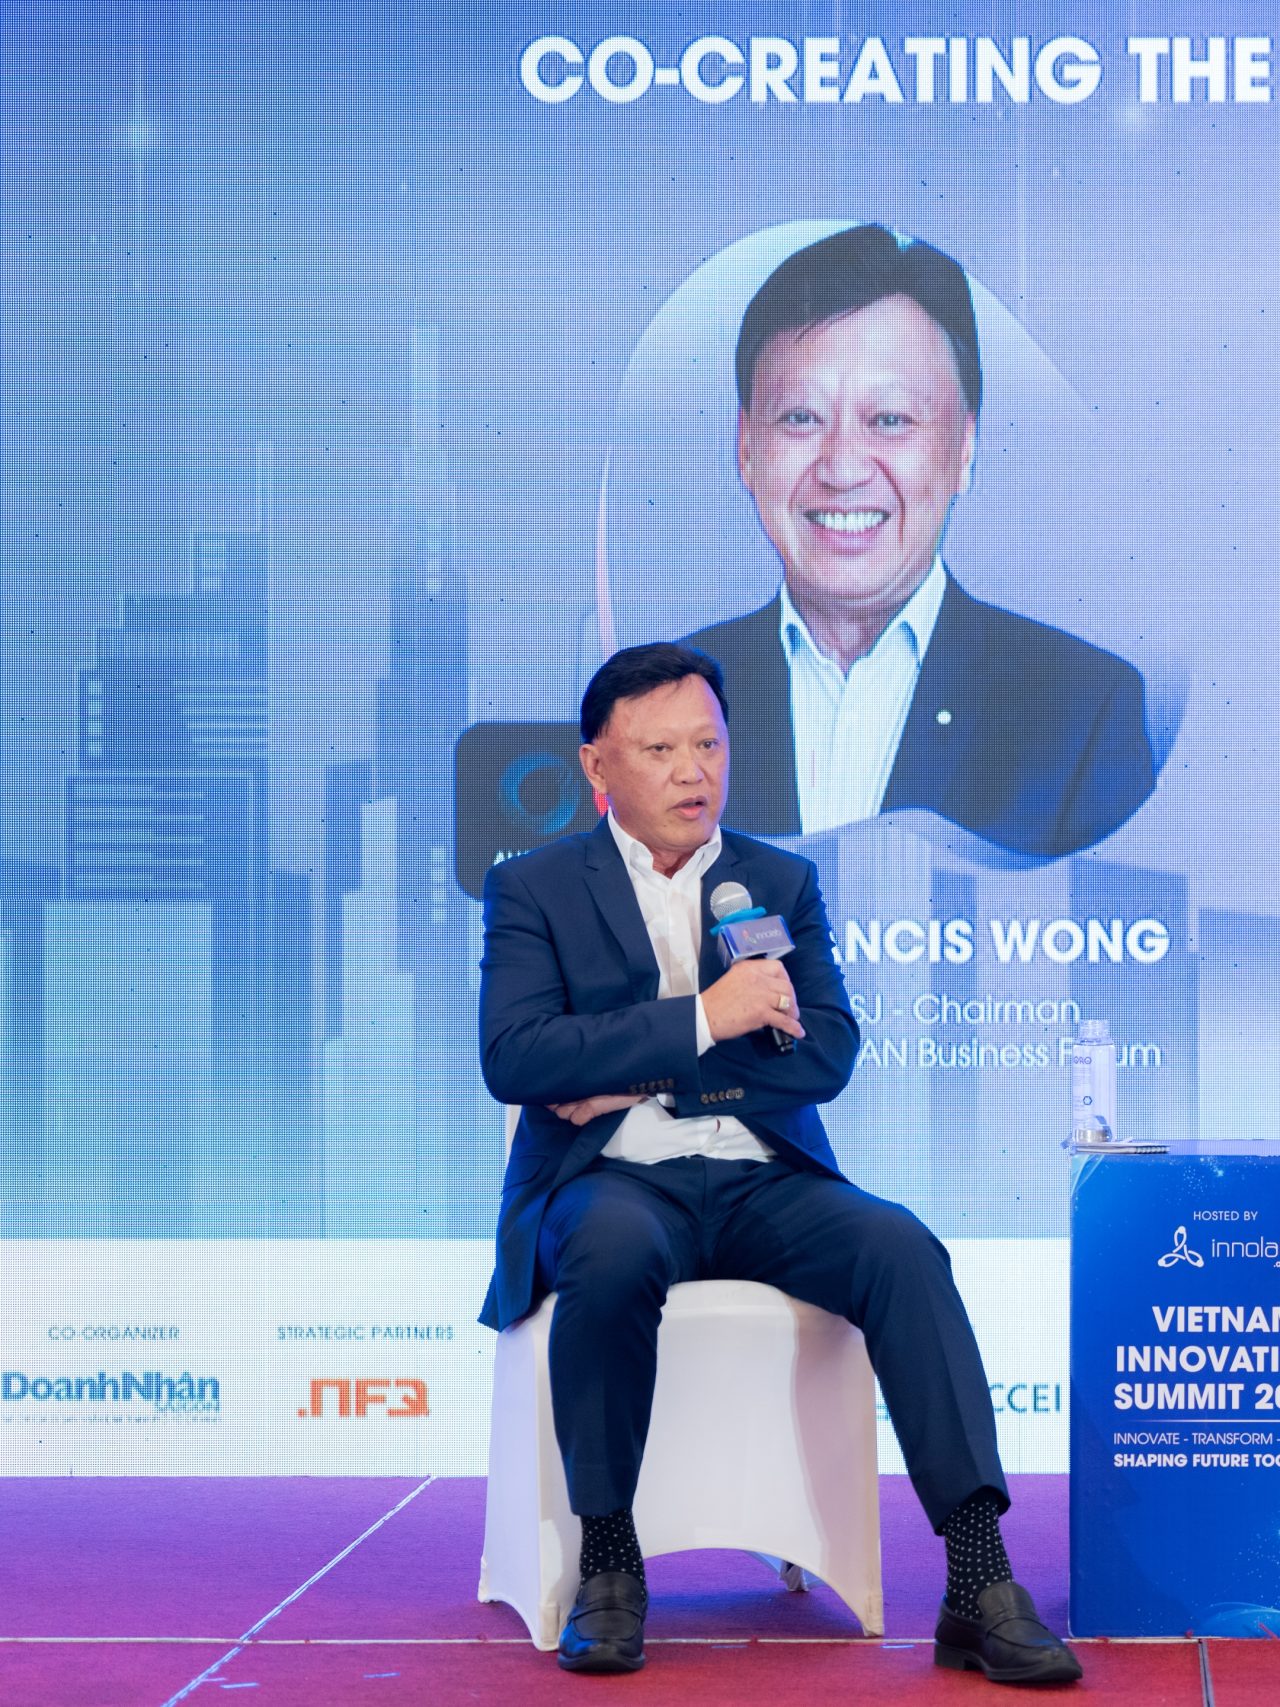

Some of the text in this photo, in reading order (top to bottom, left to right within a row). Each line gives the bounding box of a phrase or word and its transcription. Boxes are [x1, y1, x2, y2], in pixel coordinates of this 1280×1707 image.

[521, 36, 1103, 104] CO-CREATING
[1128, 36, 1272, 103] THE
[991, 919, 1171, 964] WONG
[912, 993, 1081, 1025] Chairman
[918, 1038, 1050, 1068] Business
[1059, 1038, 1162, 1068] Fum
[1193, 1211, 1258, 1221] HOSTED BY
[277, 1325, 454, 1341] STRATEGIC PARTNERS
[1, 1371, 221, 1402] DoanhNhân
[1114, 1383, 1244, 1410] SUMMIT
[1113, 1432, 1180, 1445] INNOVATE
[1191, 1432, 1273, 1445] TRANSFORM
[1113, 1453, 1188, 1468] SHAPING
[1192, 1453, 1249, 1468] FUTURE
